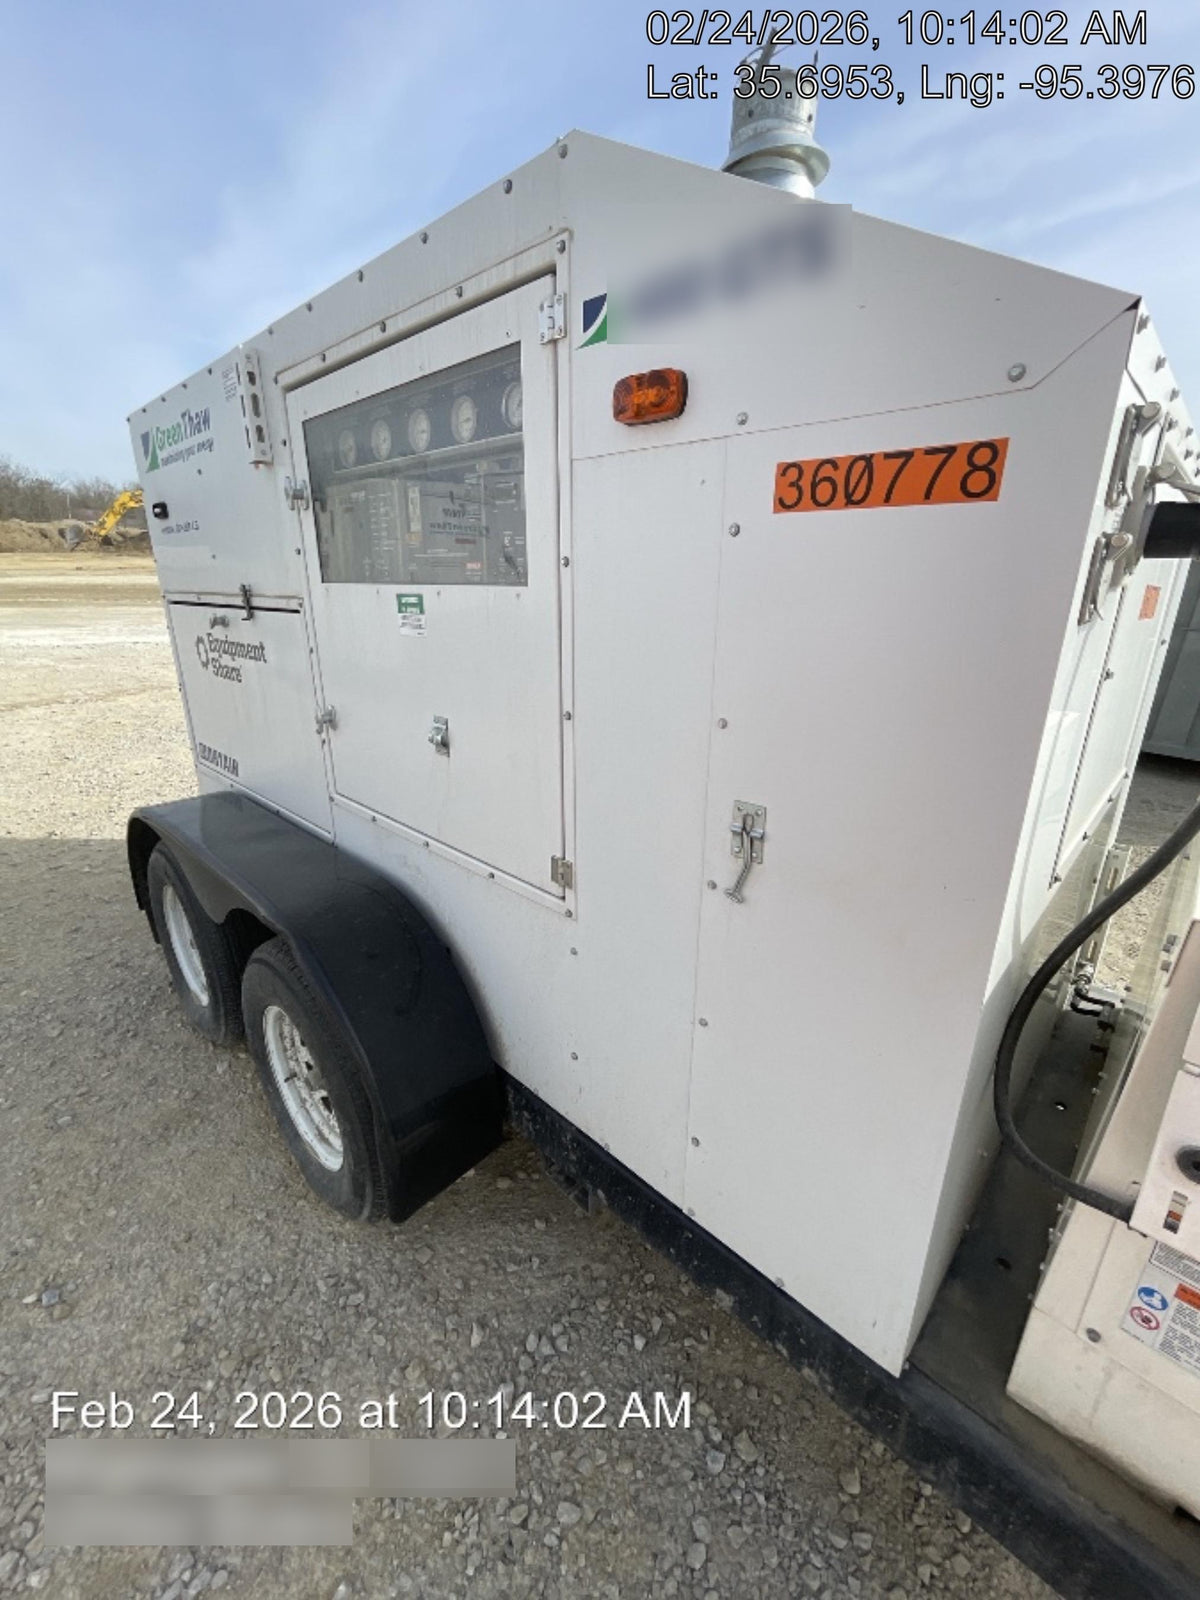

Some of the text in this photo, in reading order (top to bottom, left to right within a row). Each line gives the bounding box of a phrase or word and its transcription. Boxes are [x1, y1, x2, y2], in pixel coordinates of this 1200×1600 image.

[777, 440, 1001, 510] 360778
[206, 632, 267, 663] Equipment
[211, 657, 242, 683] Share
